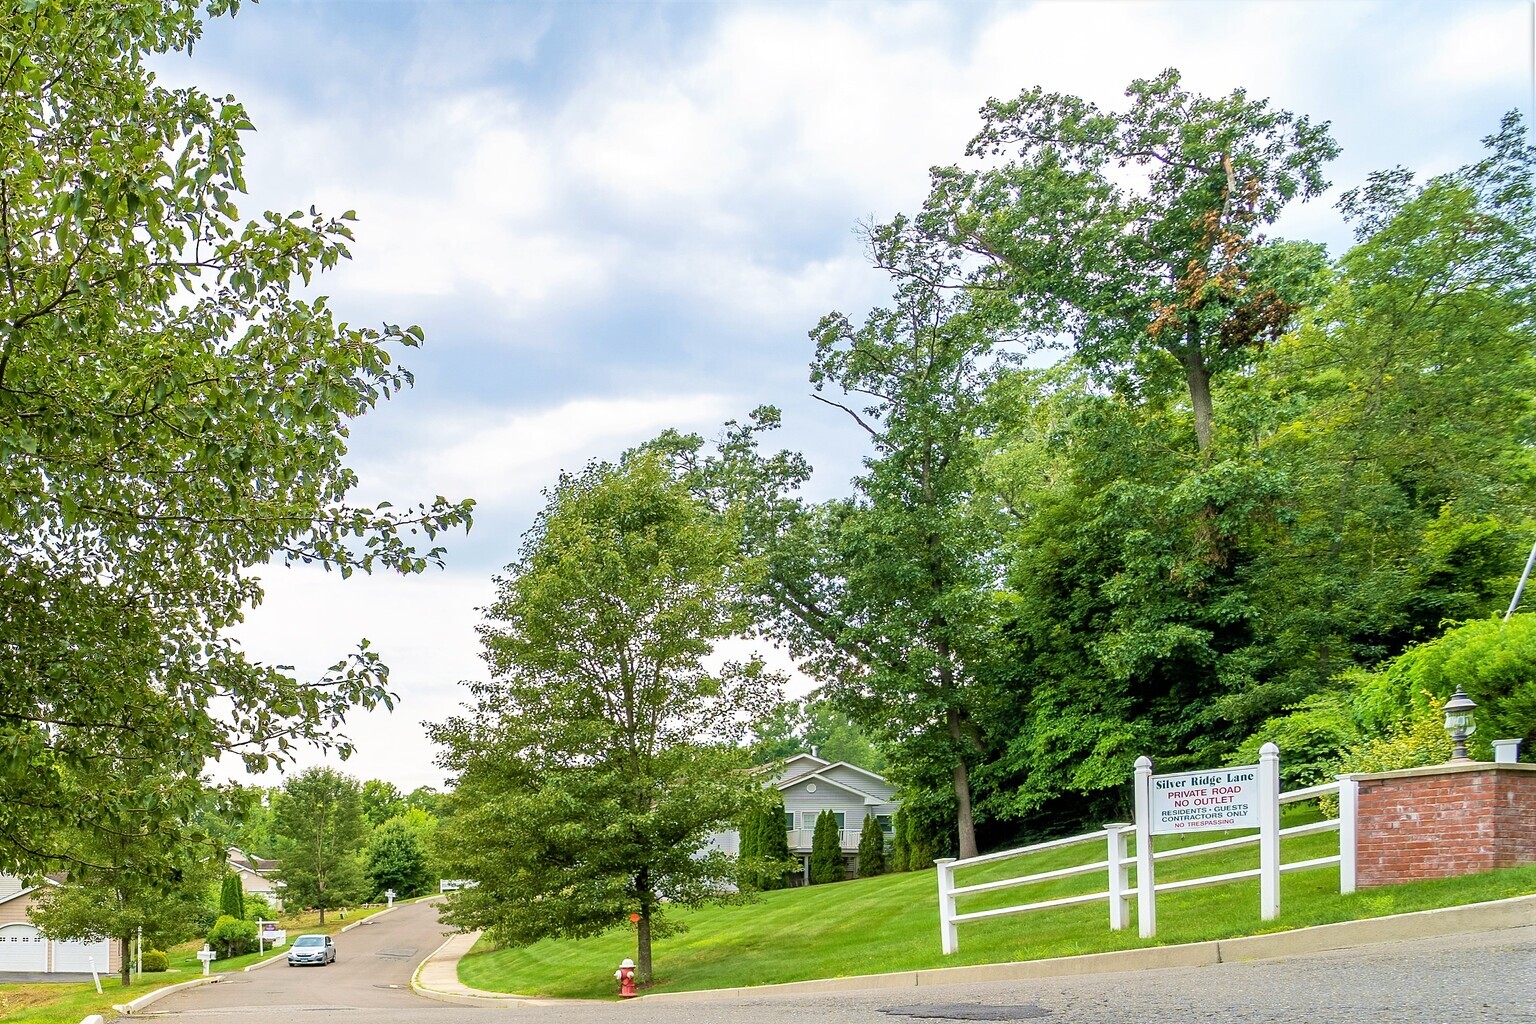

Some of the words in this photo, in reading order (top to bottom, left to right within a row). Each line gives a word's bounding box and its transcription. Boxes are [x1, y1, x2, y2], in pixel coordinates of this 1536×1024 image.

[1156, 779, 1186, 790] Silver
[1191, 775, 1222, 786] Ridge
[1227, 773, 1254, 783] Lane
[1168, 789, 1207, 799] PRIVATE
[1212, 786, 1241, 795] ROAD
[1174, 799, 1189, 807] NO
[1194, 796, 1234, 805] OUTLET
[1161, 807, 1207, 816] RESIDENTS
[1214, 804, 1248, 812] GUESTS
[1161, 812, 1223, 822] CONTRACTORS
[1188, 819, 1234, 827] TRESPASSING
